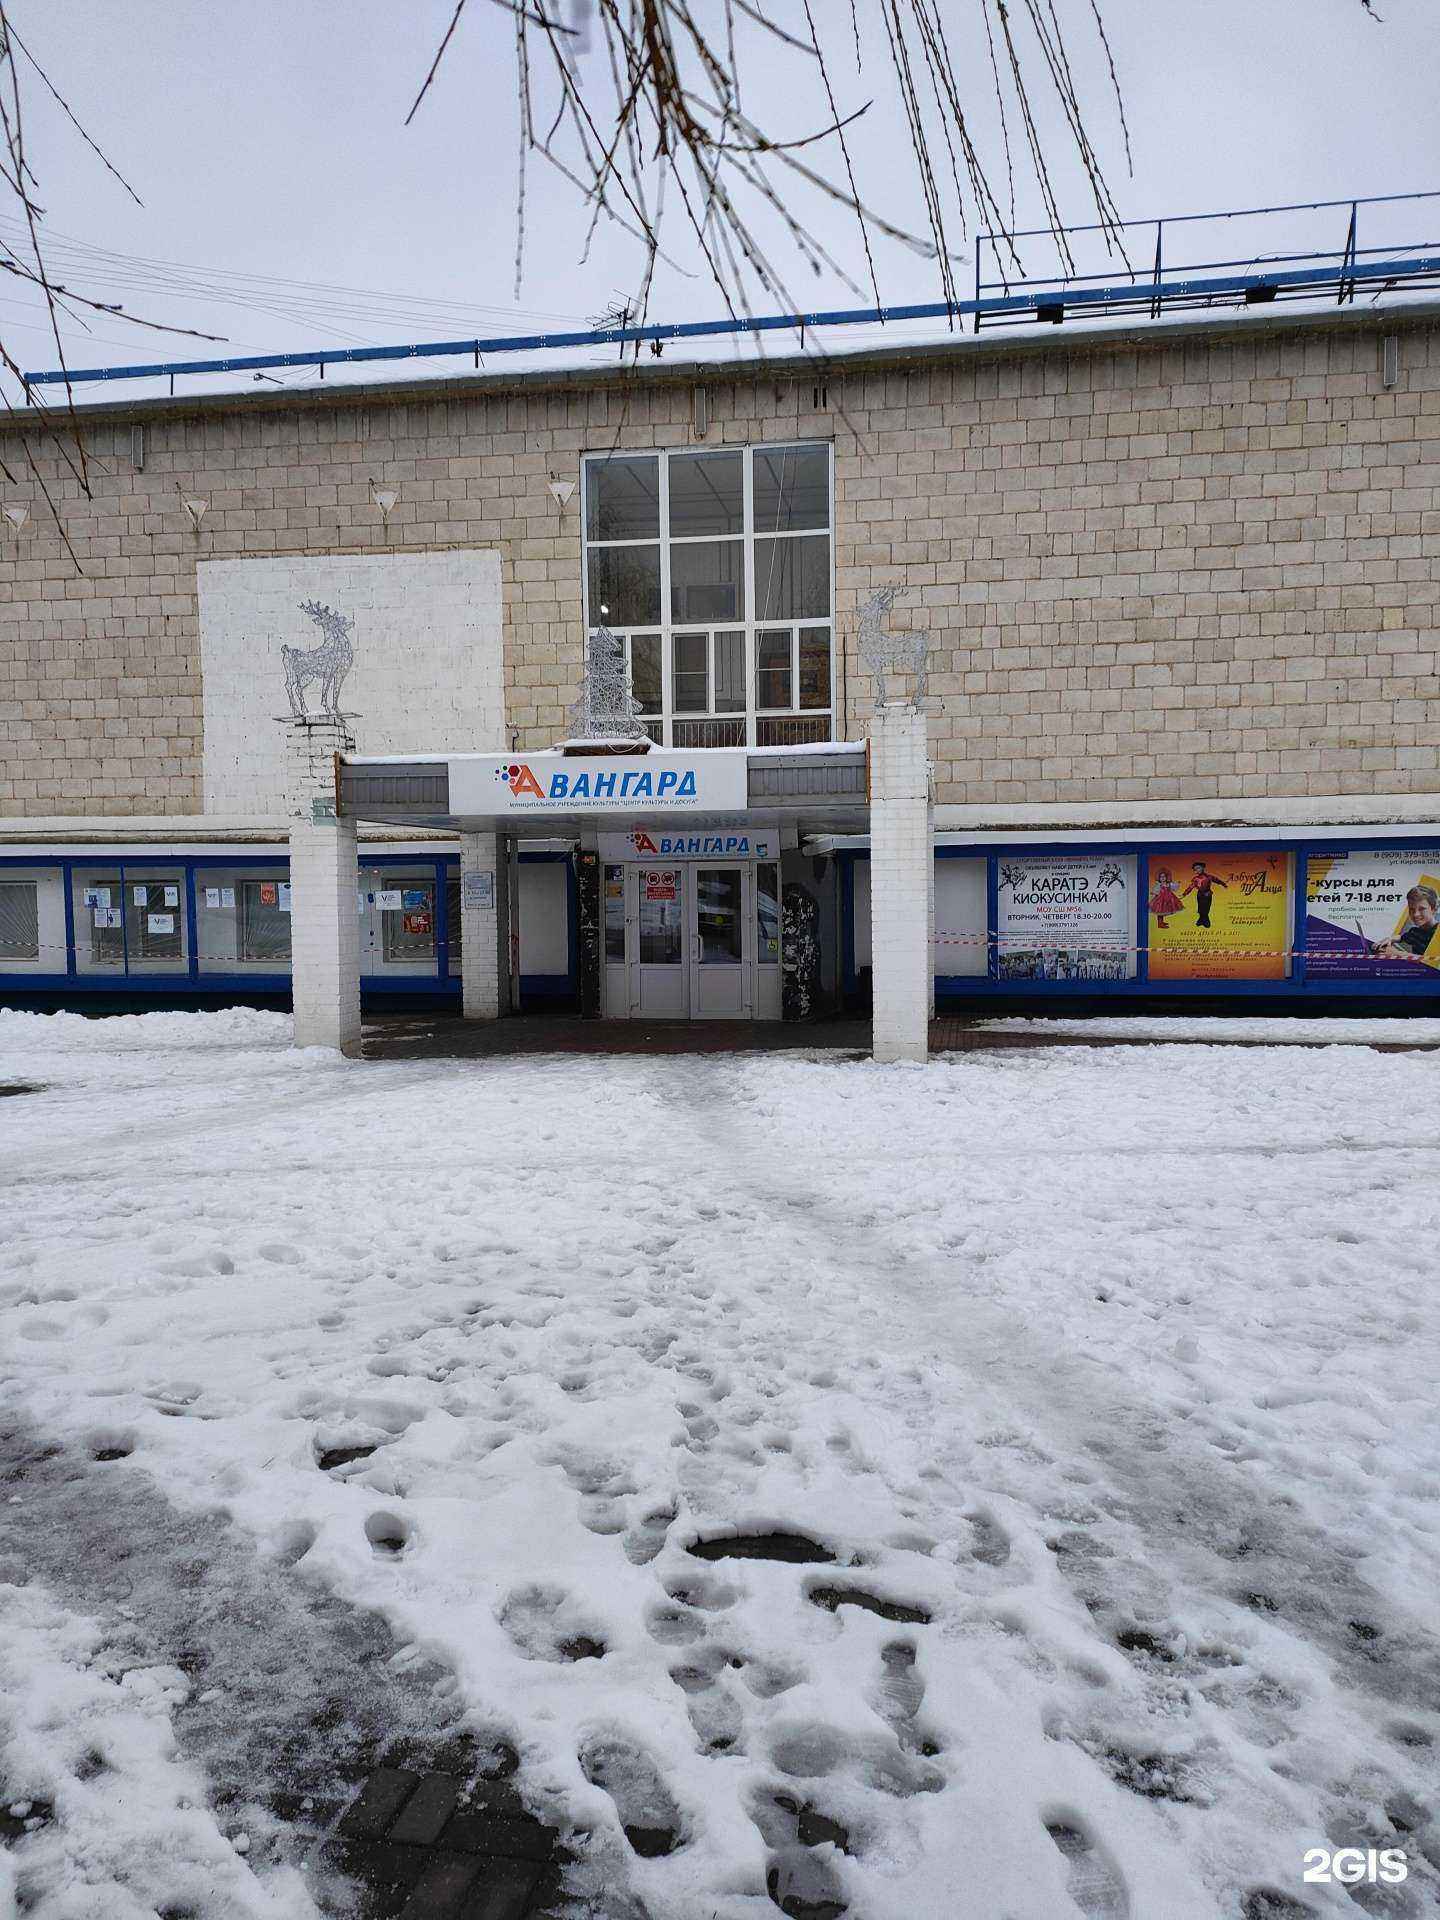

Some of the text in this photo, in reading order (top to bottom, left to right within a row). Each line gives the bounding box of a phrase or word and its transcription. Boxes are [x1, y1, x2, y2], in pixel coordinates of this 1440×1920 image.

[510, 765, 697, 799] АВАНГАРД
[636, 834, 749, 854] АВАНГАРД
[1031, 877, 1089, 891] КАРАТЭ
[1307, 877, 1395, 889] -курсы для
[1014, 889, 1108, 904] КИОКУСИНКАЙ
[1345, 893, 1372, 903] 7-18
[1377, 894, 1403, 903] лет
